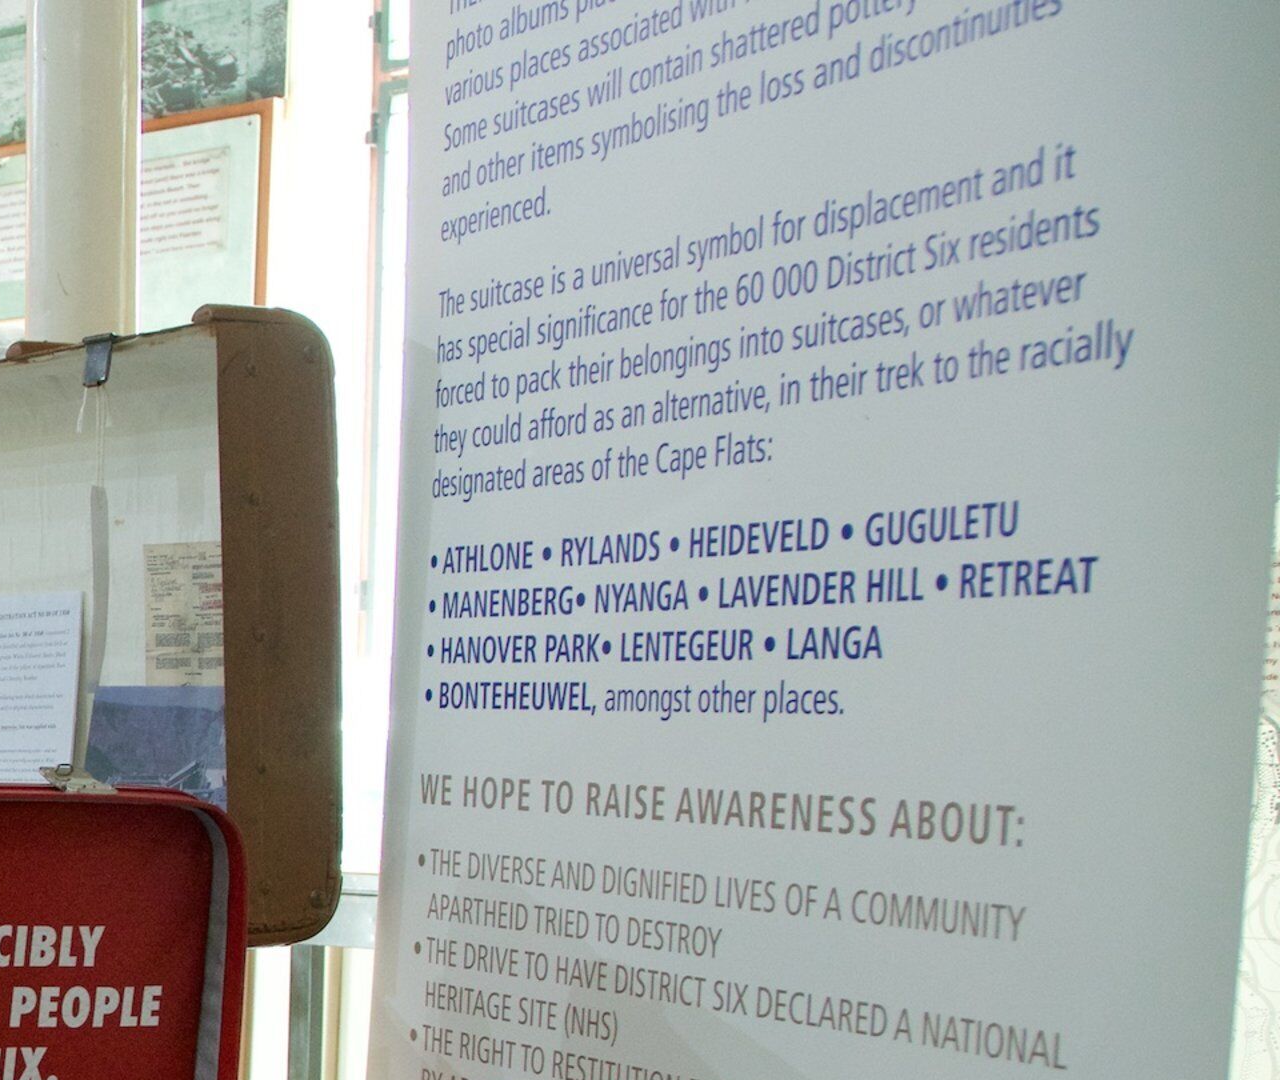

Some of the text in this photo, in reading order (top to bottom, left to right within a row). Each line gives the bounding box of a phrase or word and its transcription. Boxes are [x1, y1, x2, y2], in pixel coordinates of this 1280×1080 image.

[440, 145, 1074, 319] The suitcase is a universal symbol for displacement and it
[436, 205, 1101, 365] has special significance for the 60 000 District Six residents
[442, 500, 1021, 575] ATHLONE RYLANDS HEIDEVELD GUGULETU
[442, 555, 1097, 620] MANENBERG NYANGA LAVENDER HILL RETREAT
[440, 624, 885, 665] HANOVER PARK LENTEGEUR LANGA
[438, 678, 845, 724] BONTEHEUWEL, amongst other places.
[420, 773, 1025, 848] WE HOPE TO RAISE AWARENESS ABOUT:
[9, 984, 163, 1029] PEOPLE
